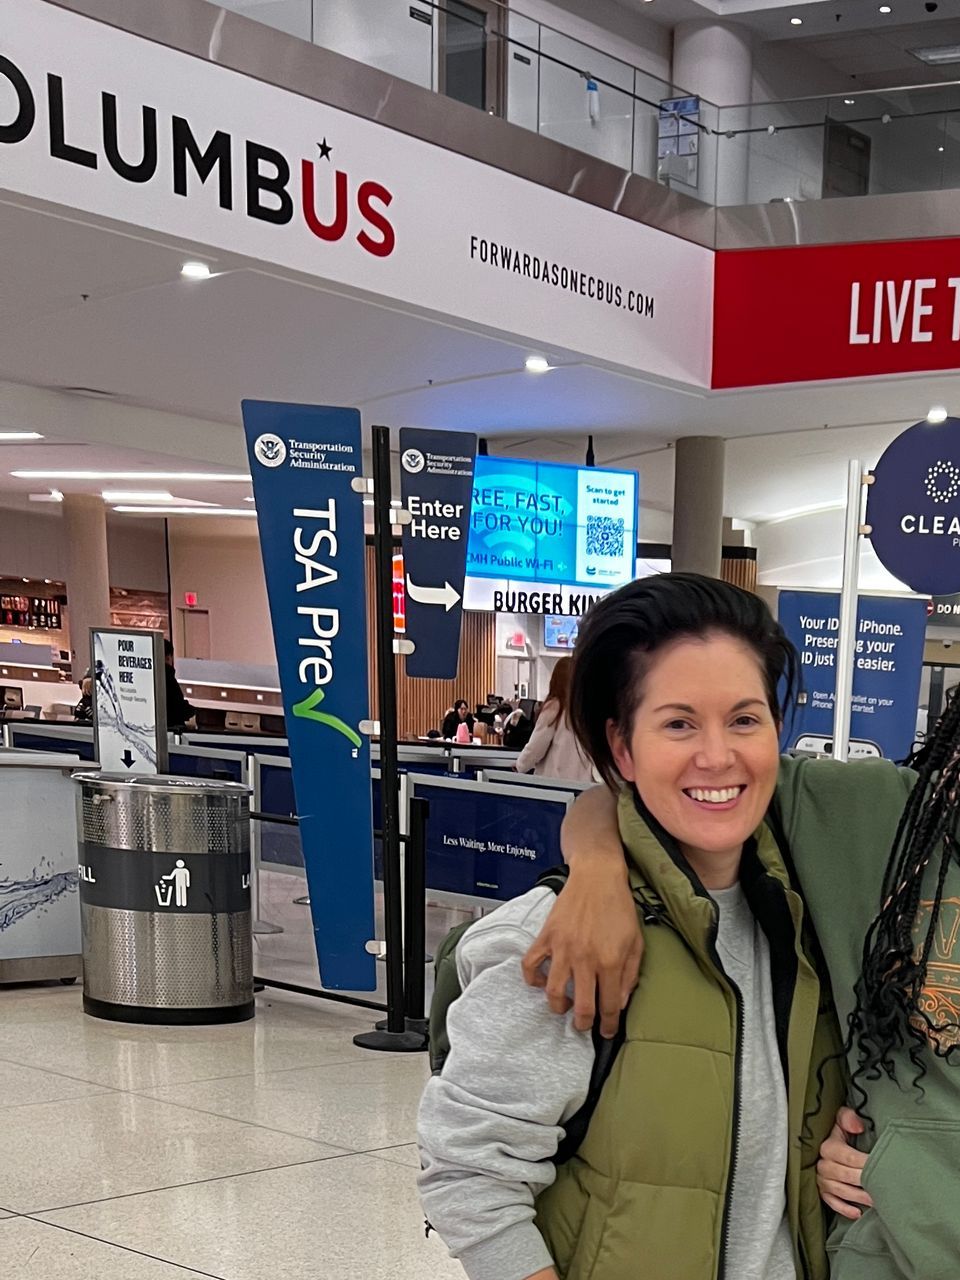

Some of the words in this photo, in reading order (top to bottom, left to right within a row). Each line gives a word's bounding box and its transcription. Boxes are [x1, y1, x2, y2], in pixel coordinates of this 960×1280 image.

[470, 235, 655, 318] FORWARDASONECBUS.COM
[849, 278, 936, 344] LIVE
[288, 439, 354, 453] Transportation
[289, 449, 327, 462] Security
[426, 452, 473, 463] Transportation
[289, 459, 356, 472] Administration
[426, 460, 453, 470] Security
[426, 467, 474, 476] Administration
[586, 485, 604, 494] Scan
[604, 487, 613, 495] to
[613, 489, 626, 498] get
[407, 495, 464, 519] Enter
[515, 491, 566, 515] FAST,
[592, 497, 619, 506] started
[411, 518, 462, 541] Here
[473, 511, 512, 532] FOR
[517, 515, 563, 537] YOU!
[292, 497, 339, 593] TSA
[490, 553, 523, 569] Public
[494, 590, 563, 615] BURGER
[936, 603, 952, 614] DO
[799, 615, 826, 630] Your
[827, 617, 839, 631] ID
[859, 619, 904, 636] iPhone.
[117, 639, 135, 652] POUR
[296, 606, 340, 686] Pre
[866, 640, 895, 655] your
[118, 655, 153, 670] BEVERAGES
[801, 651, 813, 664] ID
[813, 652, 834, 668] just
[857, 657, 896, 672] easier.
[119, 671, 134, 684] HERE
[443, 834, 459, 846] Less
[487, 841, 506, 853] More
[506, 843, 537, 860] Enjoying
